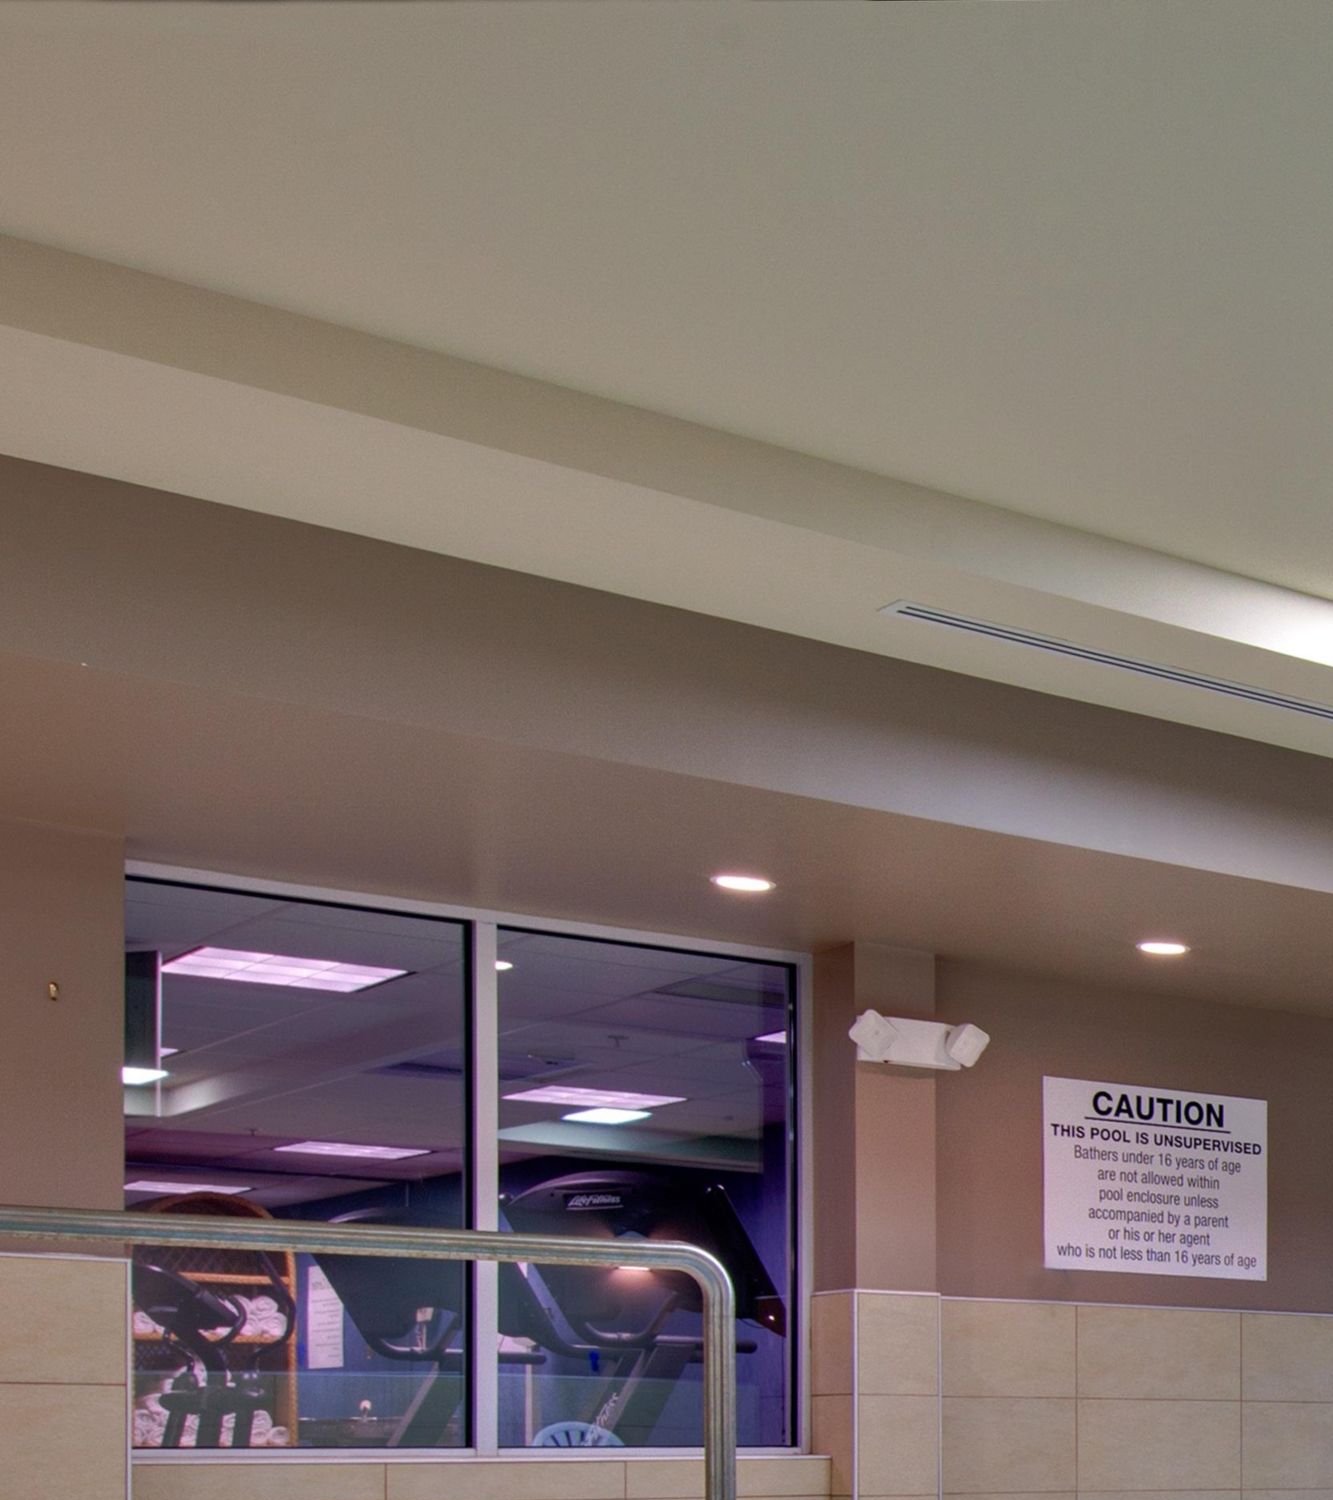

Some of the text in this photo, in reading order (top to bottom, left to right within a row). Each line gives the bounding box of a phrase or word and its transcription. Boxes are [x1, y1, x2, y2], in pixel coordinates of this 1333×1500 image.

[1092, 1091, 1224, 1128] CAUTION
[1051, 1124, 1262, 1155] THIS POOL IS UNSUPERVISED
[1074, 1145, 1241, 1174] Bathers under 16 years of age
[1098, 1170, 1220, 1190] are not allowed within
[1099, 1188, 1218, 1208] pool enclosure unless
[1088, 1206, 1228, 1229] accompanied by a parent
[1108, 1228, 1210, 1247] or his or her agent
[1057, 1244, 1256, 1270] who is not less than 16 years of age
